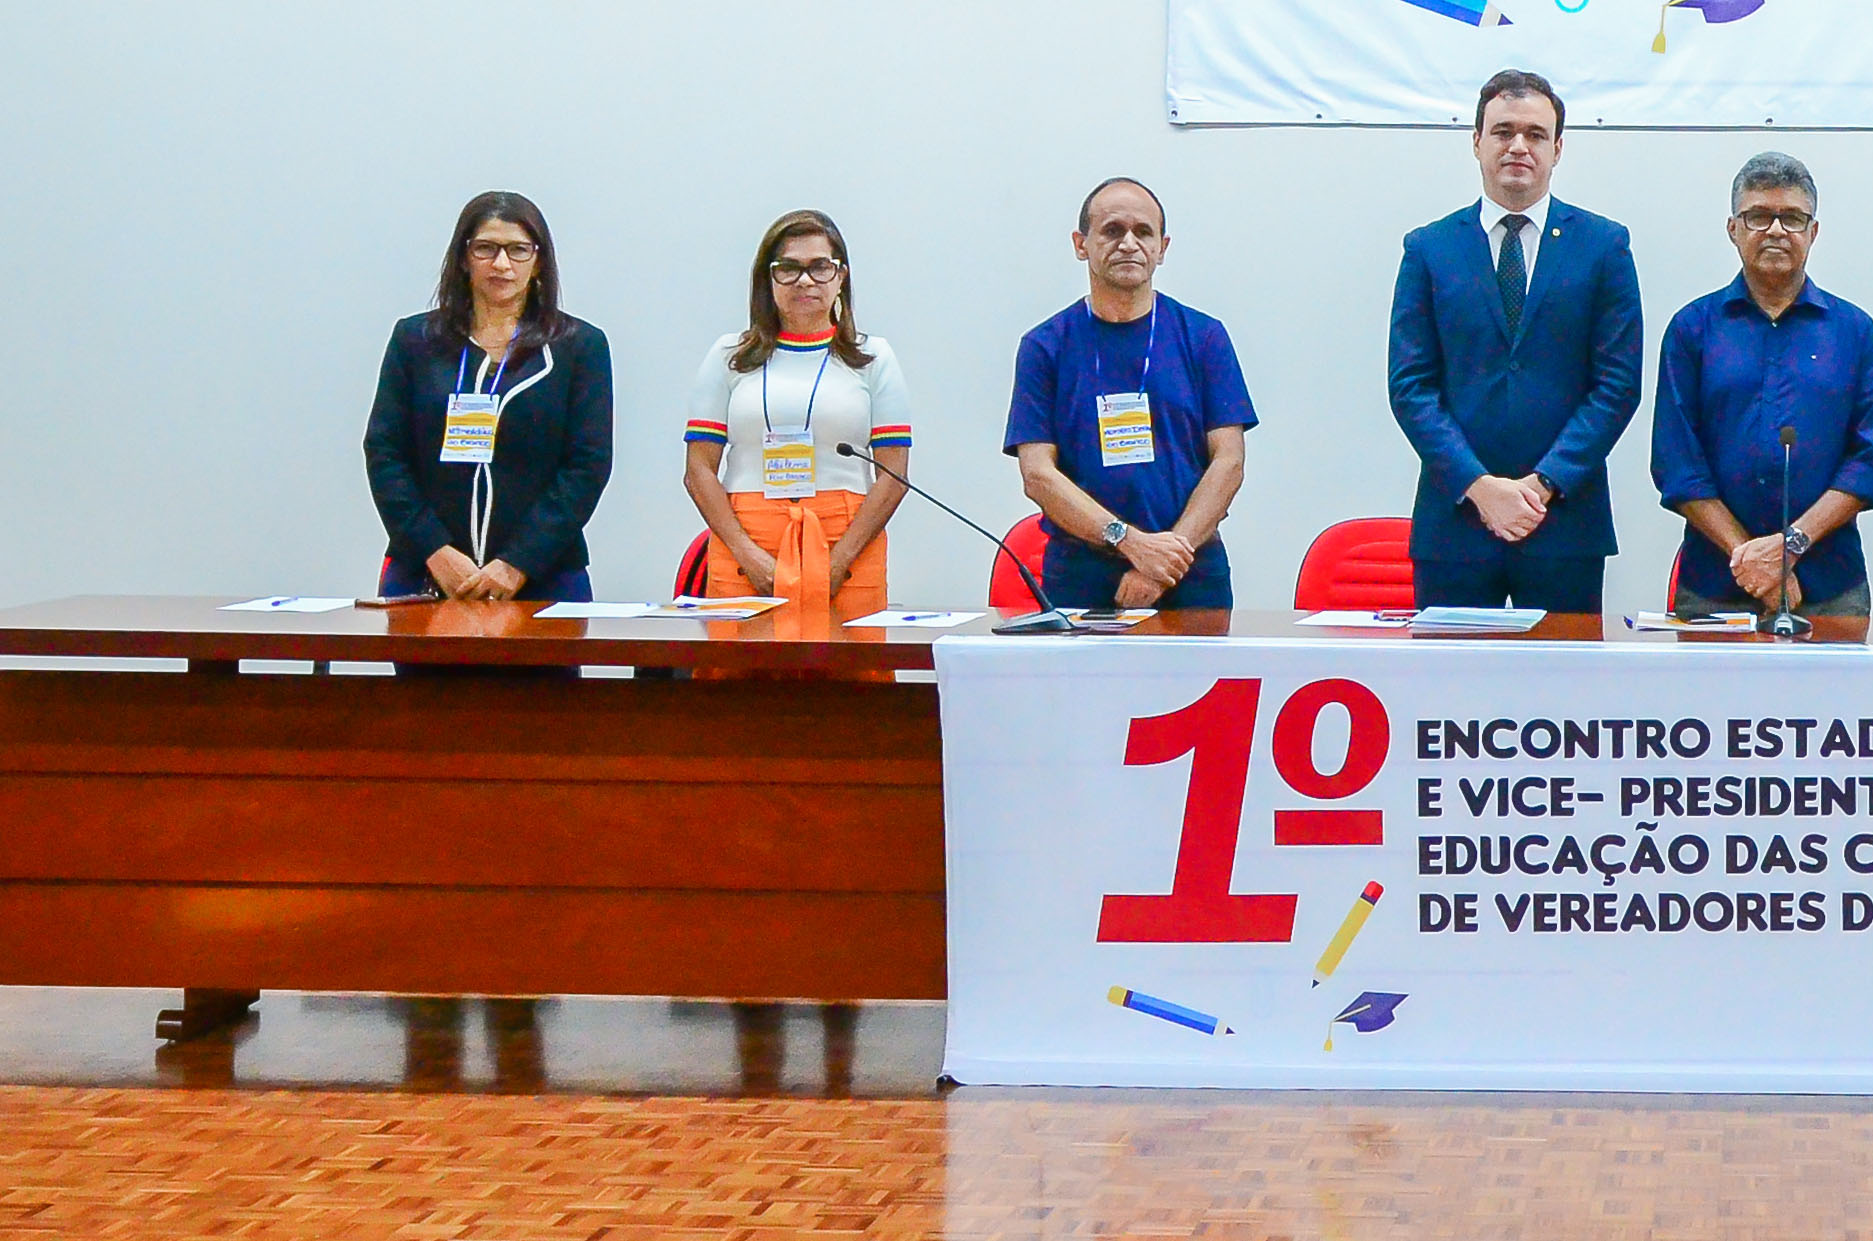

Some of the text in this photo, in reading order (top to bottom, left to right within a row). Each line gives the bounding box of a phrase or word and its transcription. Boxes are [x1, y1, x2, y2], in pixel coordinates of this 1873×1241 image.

[1416, 718, 1711, 760] ENCONTRO
[1417, 778, 1443, 818] E
[1458, 777, 1604, 817] VICE-
[1418, 821, 1710, 887] EDUCAÇÃO
[1725, 833, 1828, 874] DAS
[1419, 893, 1479, 933] DE
[1494, 892, 1826, 933] VEREADORES
